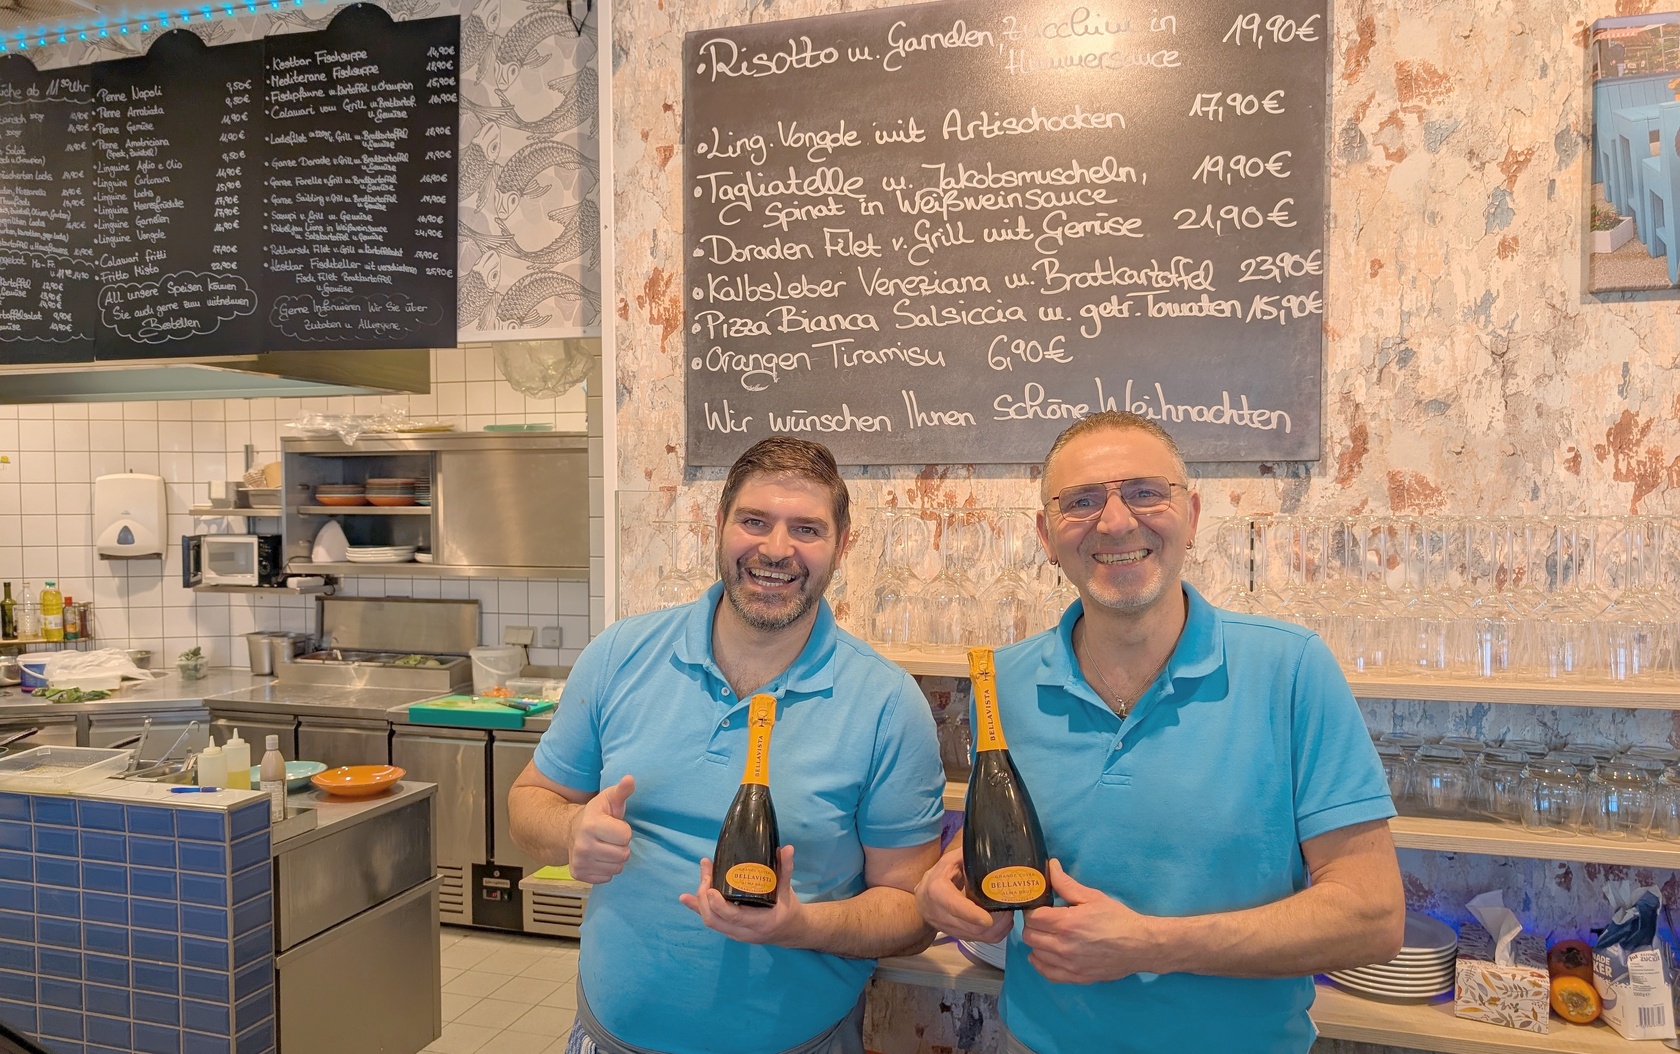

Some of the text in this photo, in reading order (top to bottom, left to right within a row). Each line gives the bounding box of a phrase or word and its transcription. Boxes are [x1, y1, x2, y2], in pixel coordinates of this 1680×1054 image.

[700, 36, 839, 82] Risotto
[1150, 9, 1177, 34] in
[1222, 13, 1321, 49] 19,90€
[314, 50, 368, 65] Fischsuppe
[332, 65, 379, 80] Fischsuppe
[26, 82, 40, 97] ab
[97, 80, 252, 103] Penne Napoli 9,50€
[97, 106, 121, 118] Penne
[225, 94, 251, 108] 9,50€
[270, 104, 316, 119] Calamari
[342, 98, 367, 113] Grill
[96, 122, 120, 134] Penne
[707, 127, 774, 165] Ling.
[875, 117, 926, 144] mit
[943, 104, 1126, 141] Artischocken
[1189, 90, 1285, 122] 17,90€
[96, 138, 119, 151] Penne
[97, 161, 130, 178] Linguine
[137, 160, 156, 174] Aglio
[222, 150, 246, 163] 9,50€
[298, 155, 332, 167] Dorade
[97, 178, 128, 192] Linguine
[134, 174, 171, 186] Carbonara
[697, 166, 866, 225] Tagliatelle
[1192, 151, 1291, 184] 19,90€
[97, 192, 128, 205] Linguine
[98, 203, 129, 219] Linguine
[763, 197, 845, 231] Spinat
[860, 198, 884, 215] in
[98, 219, 130, 233] Linguine
[700, 235, 814, 264] Doraden
[823, 228, 882, 257] Filet
[908, 219, 974, 266] Grill
[983, 215, 1034, 242] mit
[1035, 210, 1144, 255] Gemüse
[1174, 198, 1297, 235] 21,90€
[98, 234, 132, 248] Linguine
[100, 252, 139, 268] Calamari
[101, 271, 129, 283] Fritto
[134, 263, 159, 277] Misto
[858, 266, 991, 297] Veneziana
[1032, 256, 1216, 294] Bratkartoffel
[1238, 250, 1323, 283] 23,90€
[127, 288, 159, 300] unsere
[167, 281, 203, 297] Speisen
[113, 306, 131, 320] Sie
[134, 304, 155, 317] auch
[157, 301, 179, 317] gerne
[279, 303, 310, 320] Gerne
[367, 302, 382, 313] Wir
[386, 301, 400, 313] Sie
[695, 310, 772, 339] Pizza
[766, 306, 880, 333] Bianca
[893, 299, 1027, 330] Salsiccia
[1080, 295, 1141, 338] getr.
[1126, 290, 1242, 319] Tomaten
[1246, 291, 1323, 325] 15,90€
[140, 317, 201, 333] Bestellen
[303, 319, 342, 330] Zutaten
[706, 334, 1073, 391] Orangen Tiramisu 6,90€
[704, 399, 753, 433] Wir
[769, 403, 892, 432] wünschen
[902, 389, 976, 428] Ihnen
[1095, 377, 1291, 433] Weihnachten
[984, 689, 996, 741] BELLAVISTA
[755, 735, 763, 777] BELLAVISTA
[734, 873, 772, 882] BELLAVISTA
[991, 879, 1040, 888] BELLAVISTA
